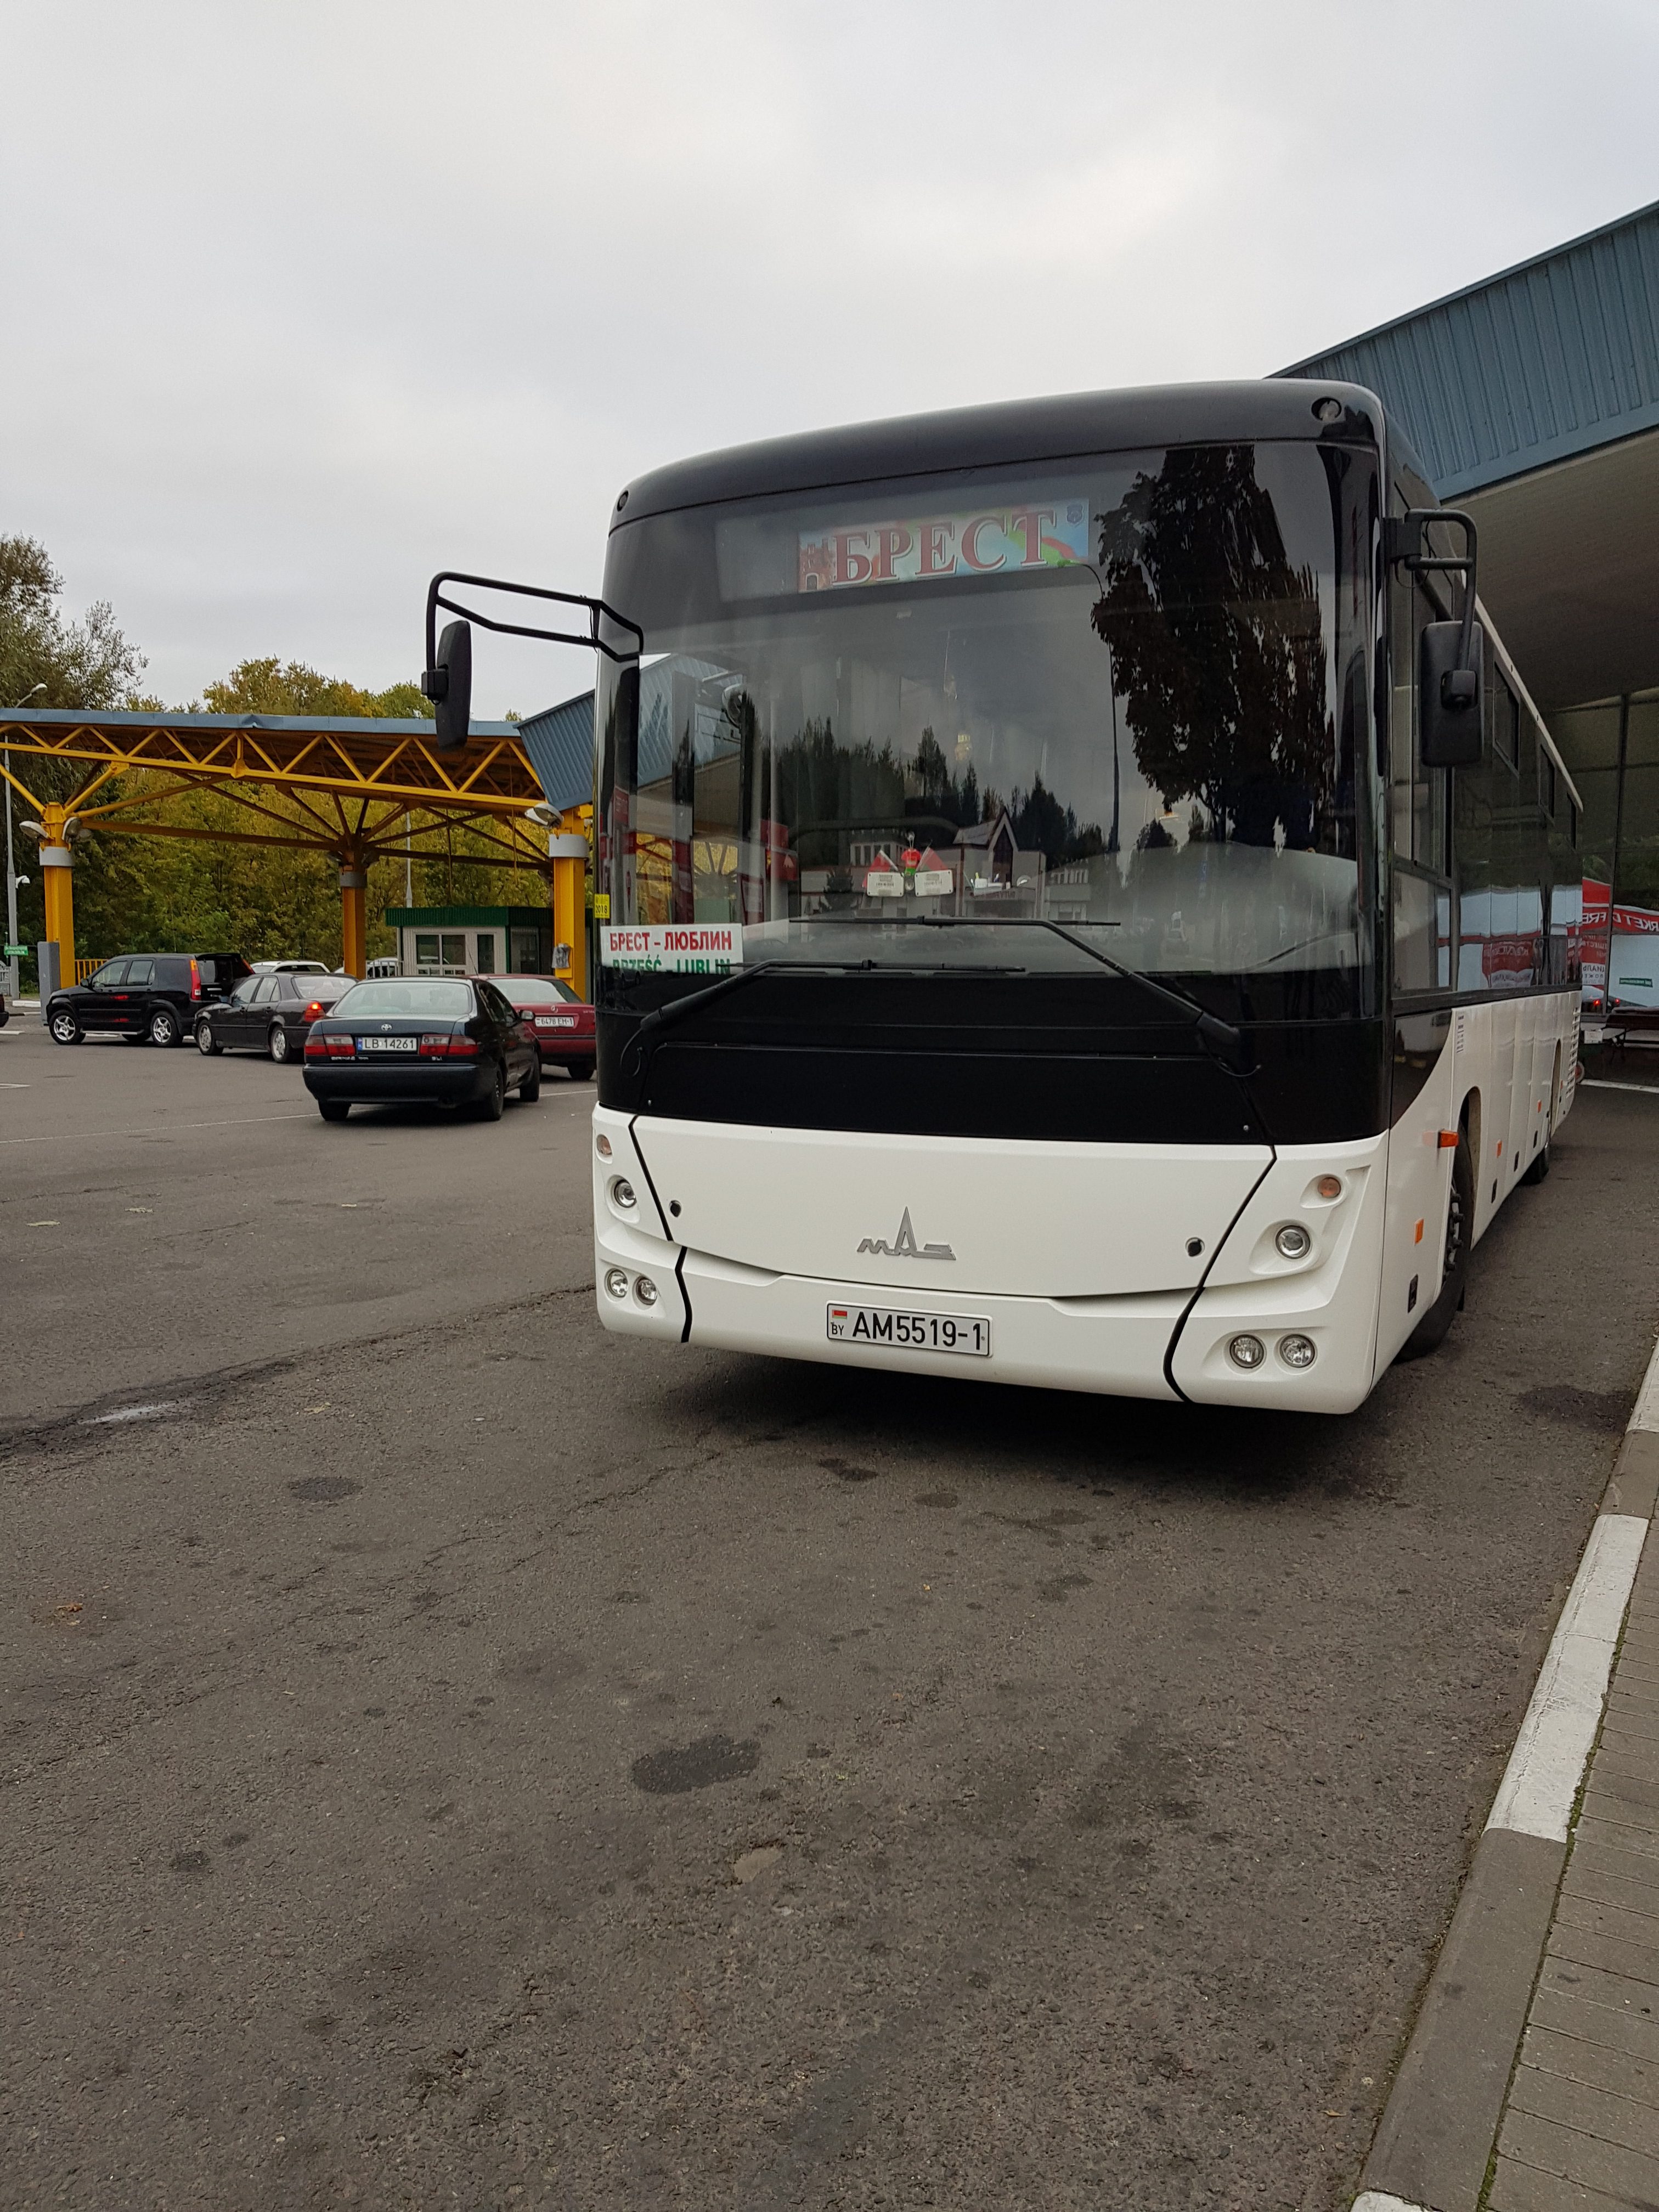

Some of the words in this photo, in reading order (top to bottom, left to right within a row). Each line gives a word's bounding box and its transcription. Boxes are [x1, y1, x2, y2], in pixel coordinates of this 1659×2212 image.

[832, 510, 1056, 585] БРЕСТ
[596, 905, 607, 914] 2018
[610, 932, 650, 951] БРЕСТ
[664, 931, 732, 951] ЛЮБЛИН
[365, 1039, 379, 1049] LB
[384, 1039, 414, 1049] 14261
[832, 1323, 844, 1336] BY
[853, 1311, 980, 1350] AM5519-1
